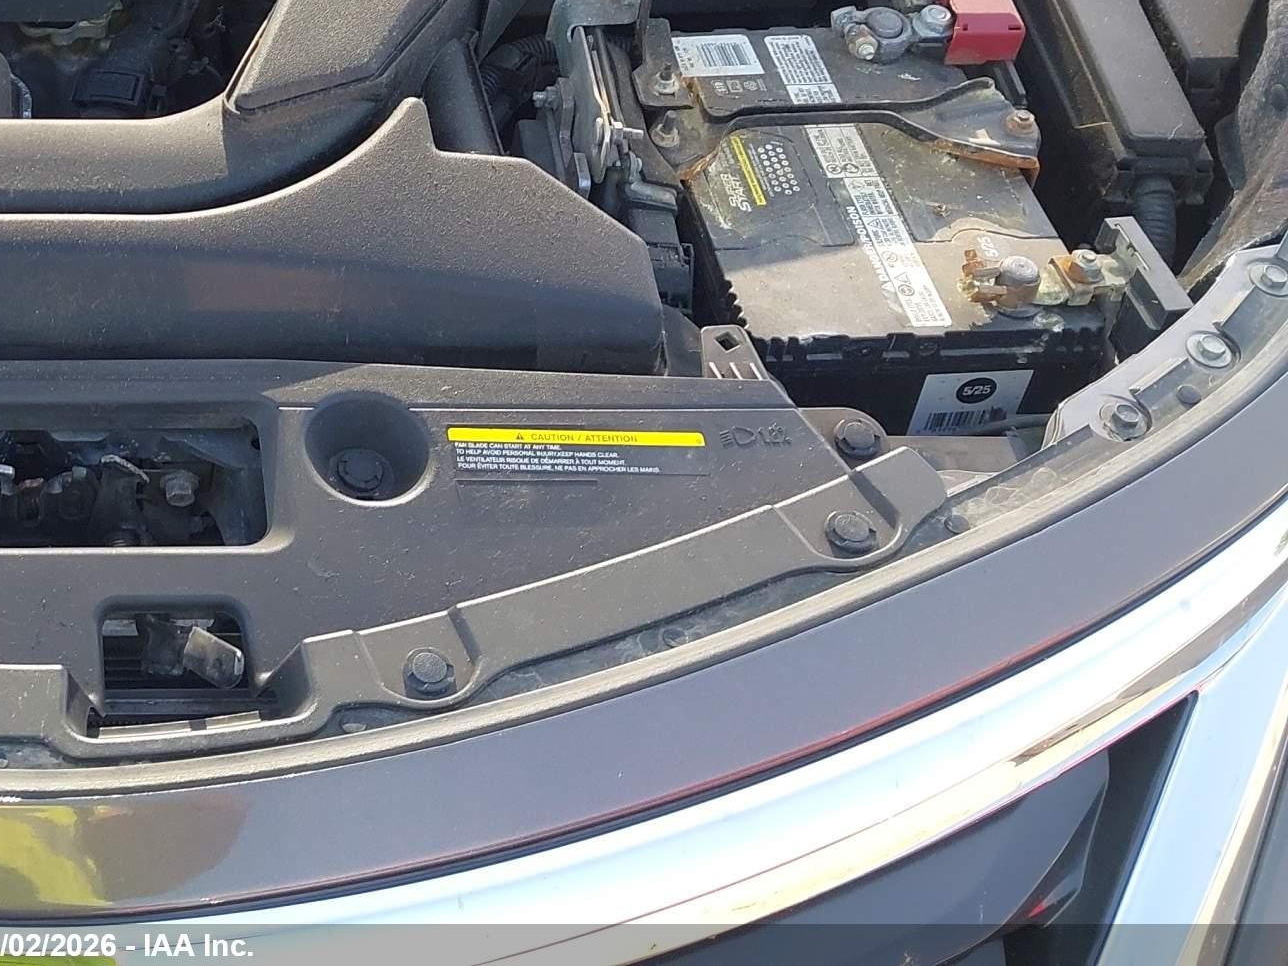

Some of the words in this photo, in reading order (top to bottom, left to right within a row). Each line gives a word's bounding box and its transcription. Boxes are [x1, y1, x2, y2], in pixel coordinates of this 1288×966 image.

[720, 173, 739, 207] SUPER
[961, 384, 992, 396] 5/25
[531, 433, 574, 441] CAUTION
[585, 434, 638, 442] ATTENTION
